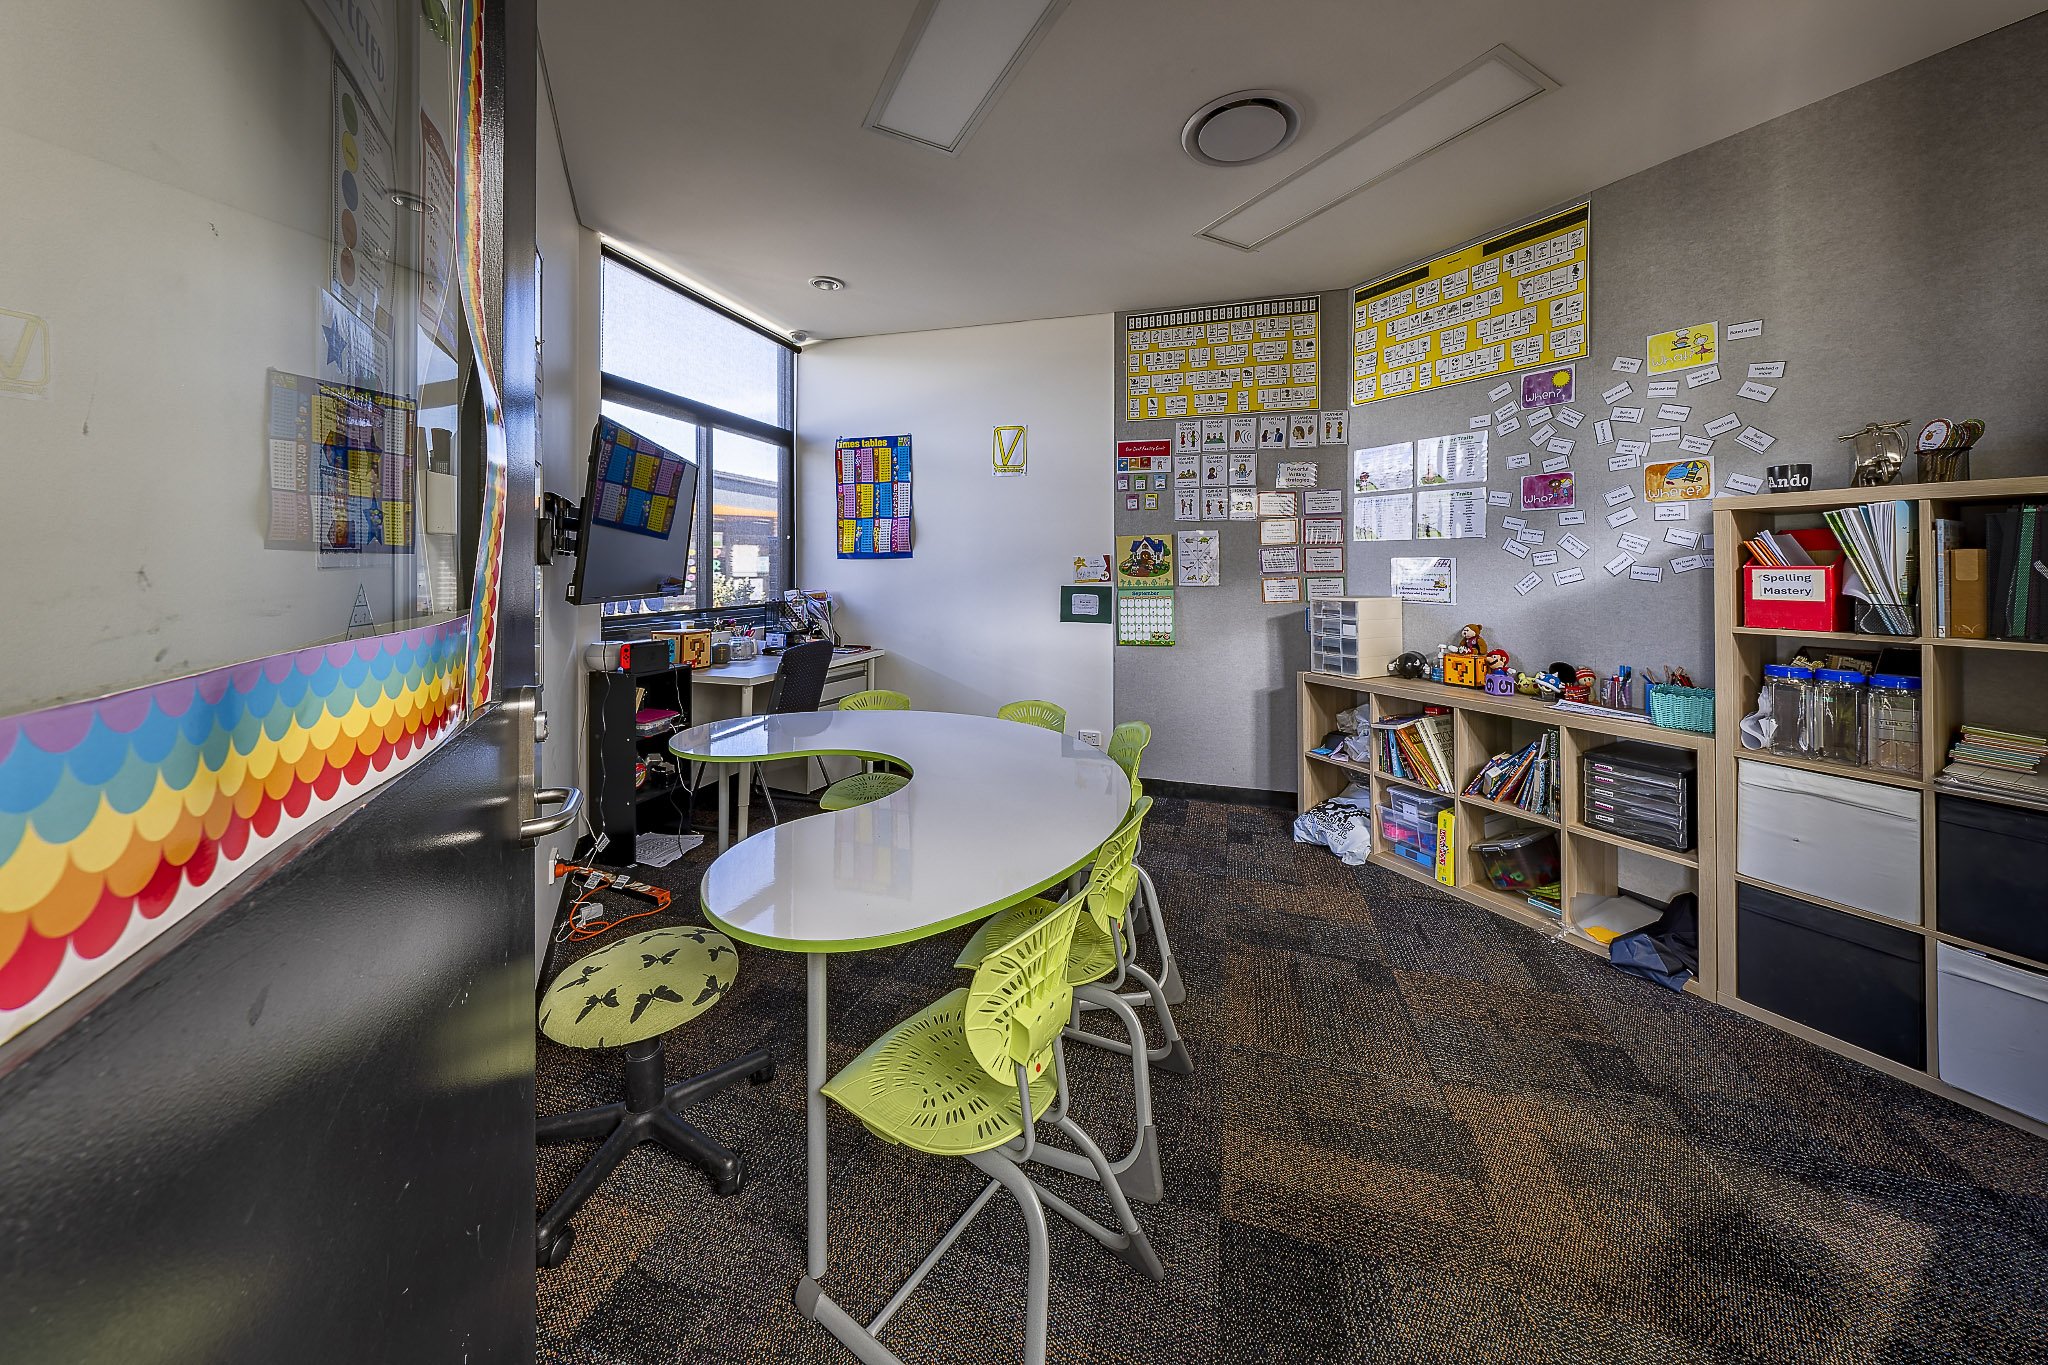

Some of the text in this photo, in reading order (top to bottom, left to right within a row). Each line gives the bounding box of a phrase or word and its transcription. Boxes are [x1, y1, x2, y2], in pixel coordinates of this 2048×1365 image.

[340, 0, 385, 82] ECTED
[1526, 389, 1562, 402] When?
[837, 438, 887, 449] times tables
[997, 430, 1022, 466] V
[1768, 474, 1809, 488] Ando
[1524, 494, 1553, 504] Who?
[1649, 486, 1702, 499] Where?
[1763, 574, 1811, 583] Spelling
[1764, 588, 1811, 596] Mastery
